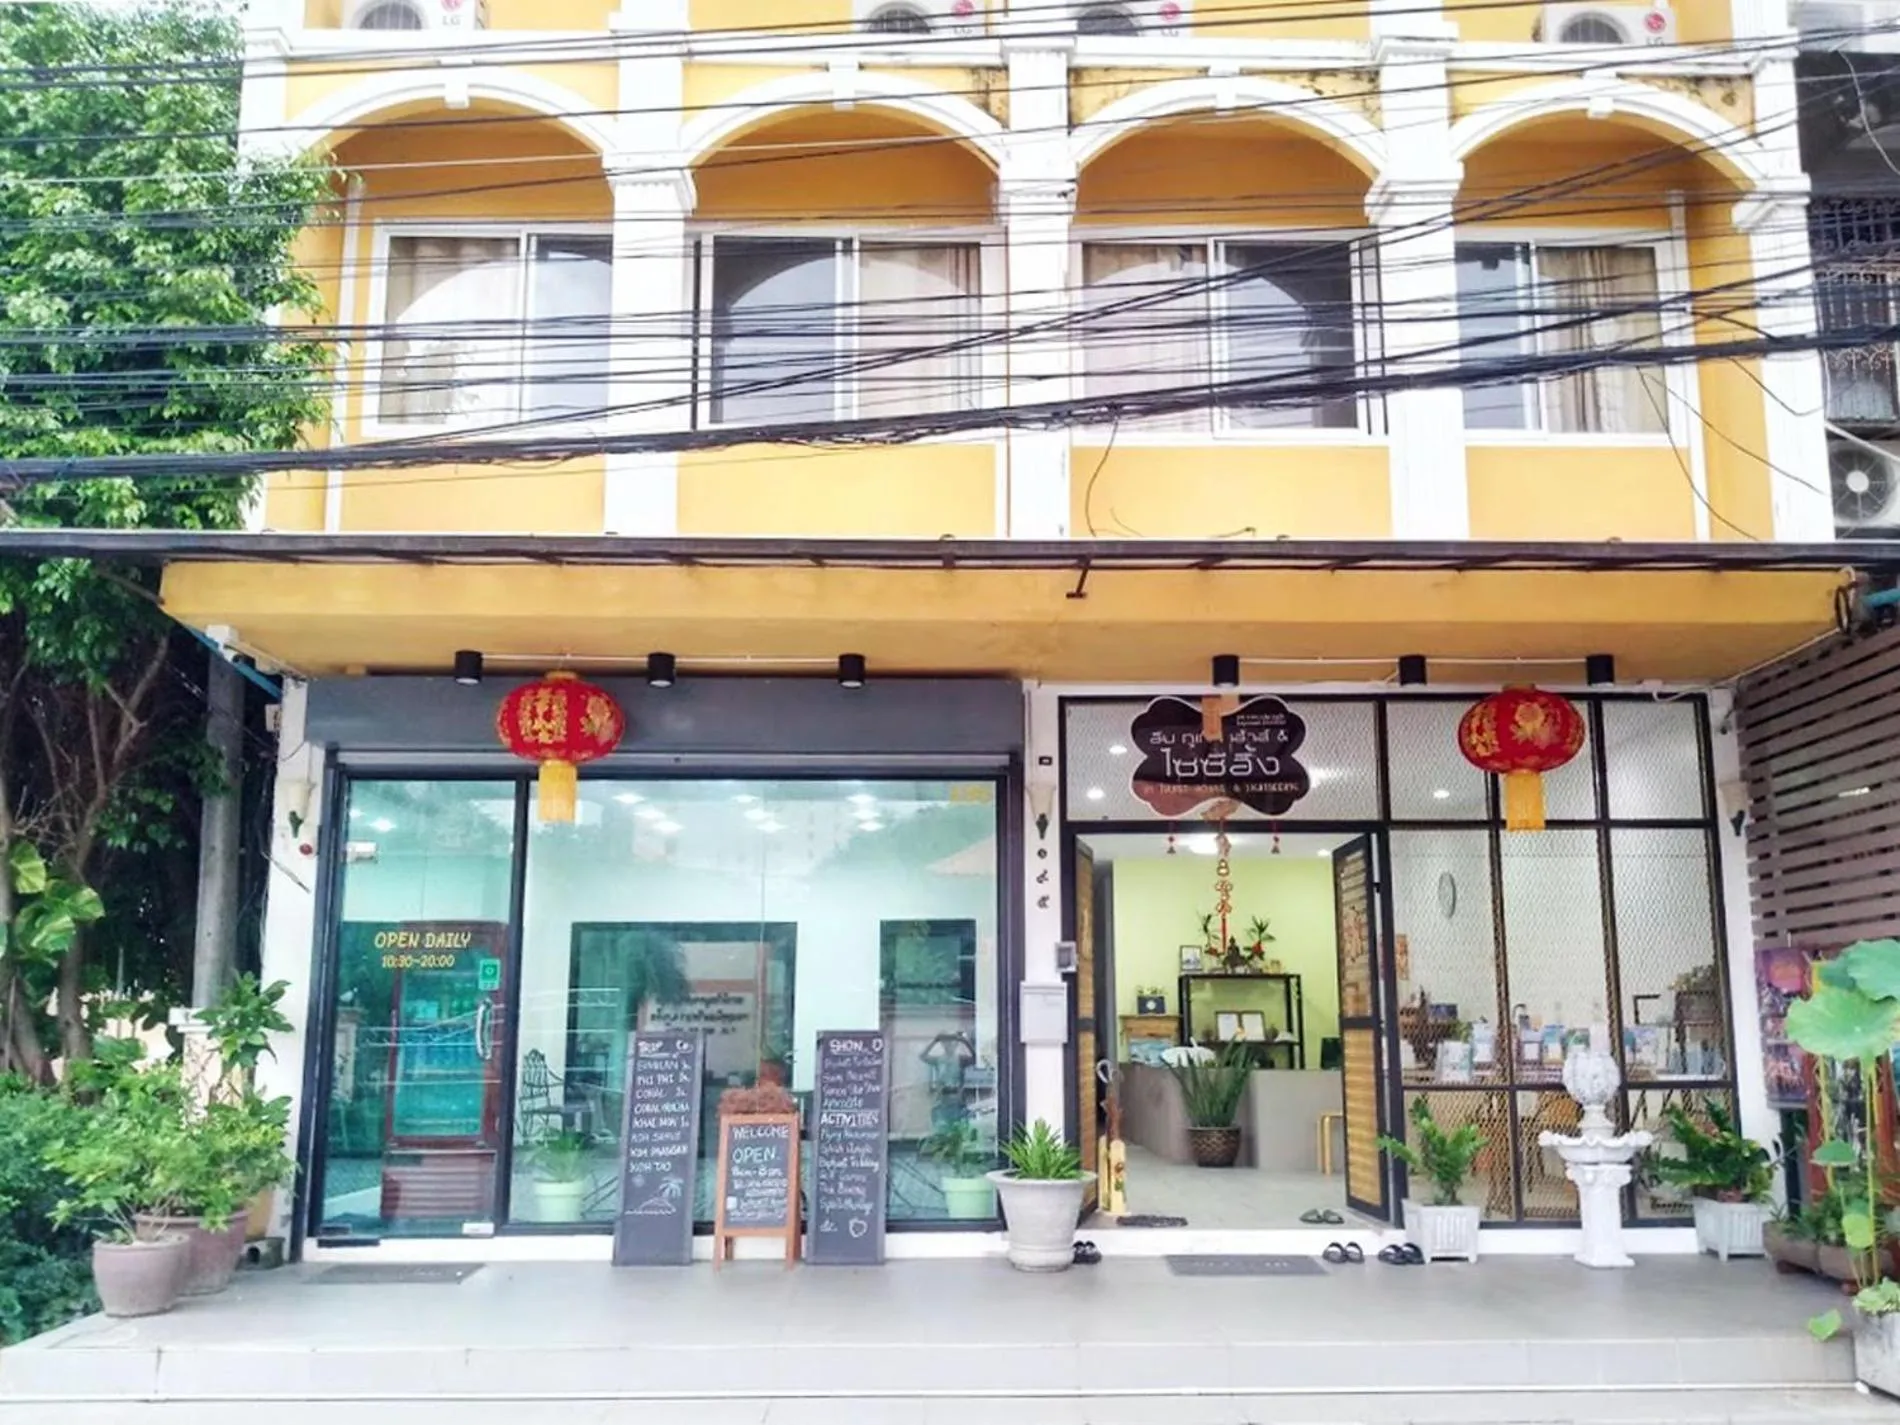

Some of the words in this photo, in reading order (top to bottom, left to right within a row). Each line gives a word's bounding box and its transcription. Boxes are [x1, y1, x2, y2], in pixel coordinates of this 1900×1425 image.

[374, 931, 420, 949] OPEN
[424, 931, 472, 949] DAILY
[731, 1125, 789, 1140] WELCOME
